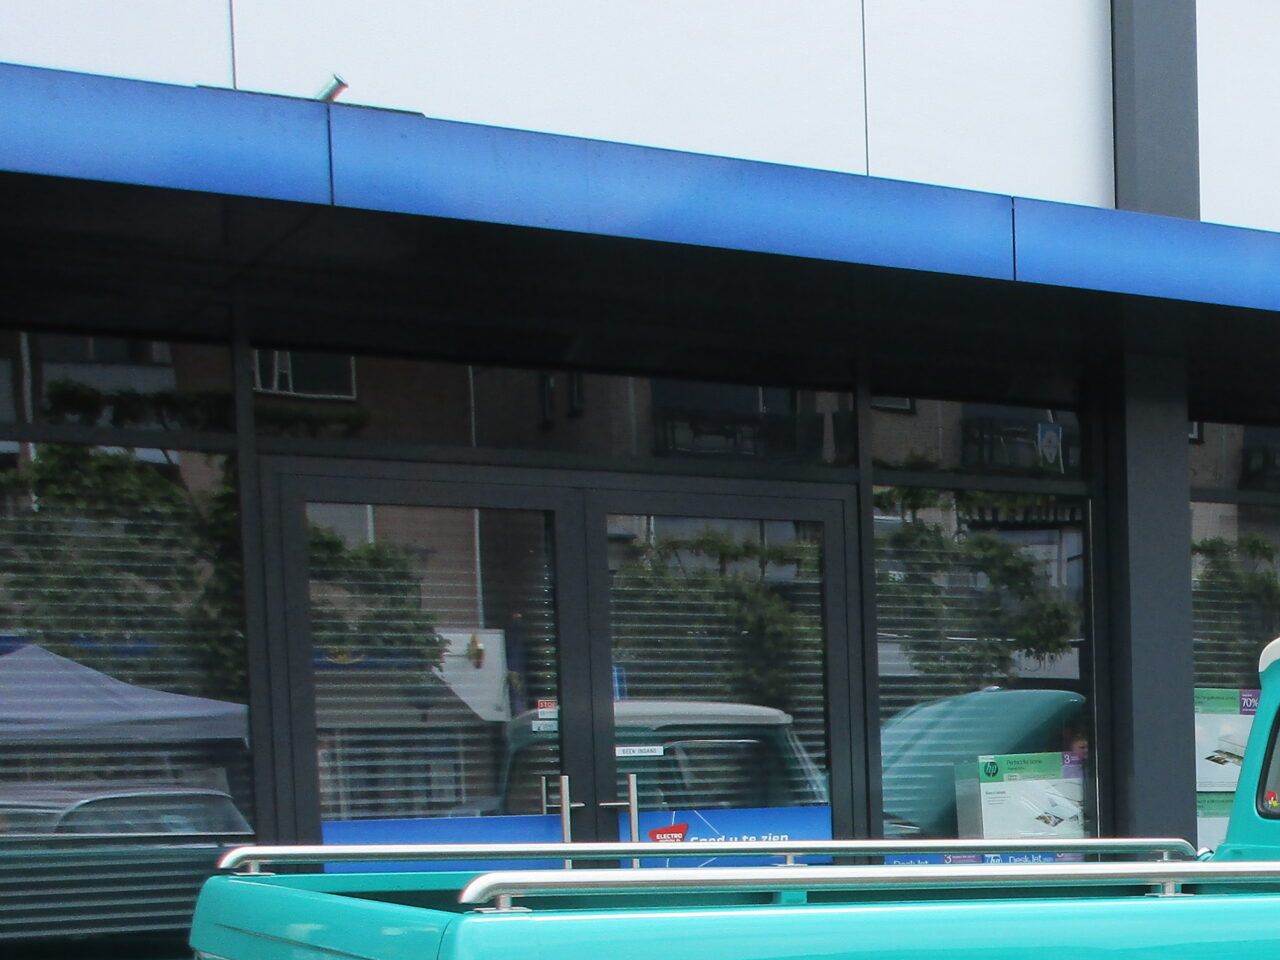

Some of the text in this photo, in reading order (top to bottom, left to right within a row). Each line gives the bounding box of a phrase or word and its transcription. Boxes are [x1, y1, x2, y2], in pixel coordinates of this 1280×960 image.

[1241, 697, 1258, 708] 70%
[1063, 754, 1071, 764] 3
[985, 762, 998, 778] hp
[656, 832, 683, 840] ELECTRO
